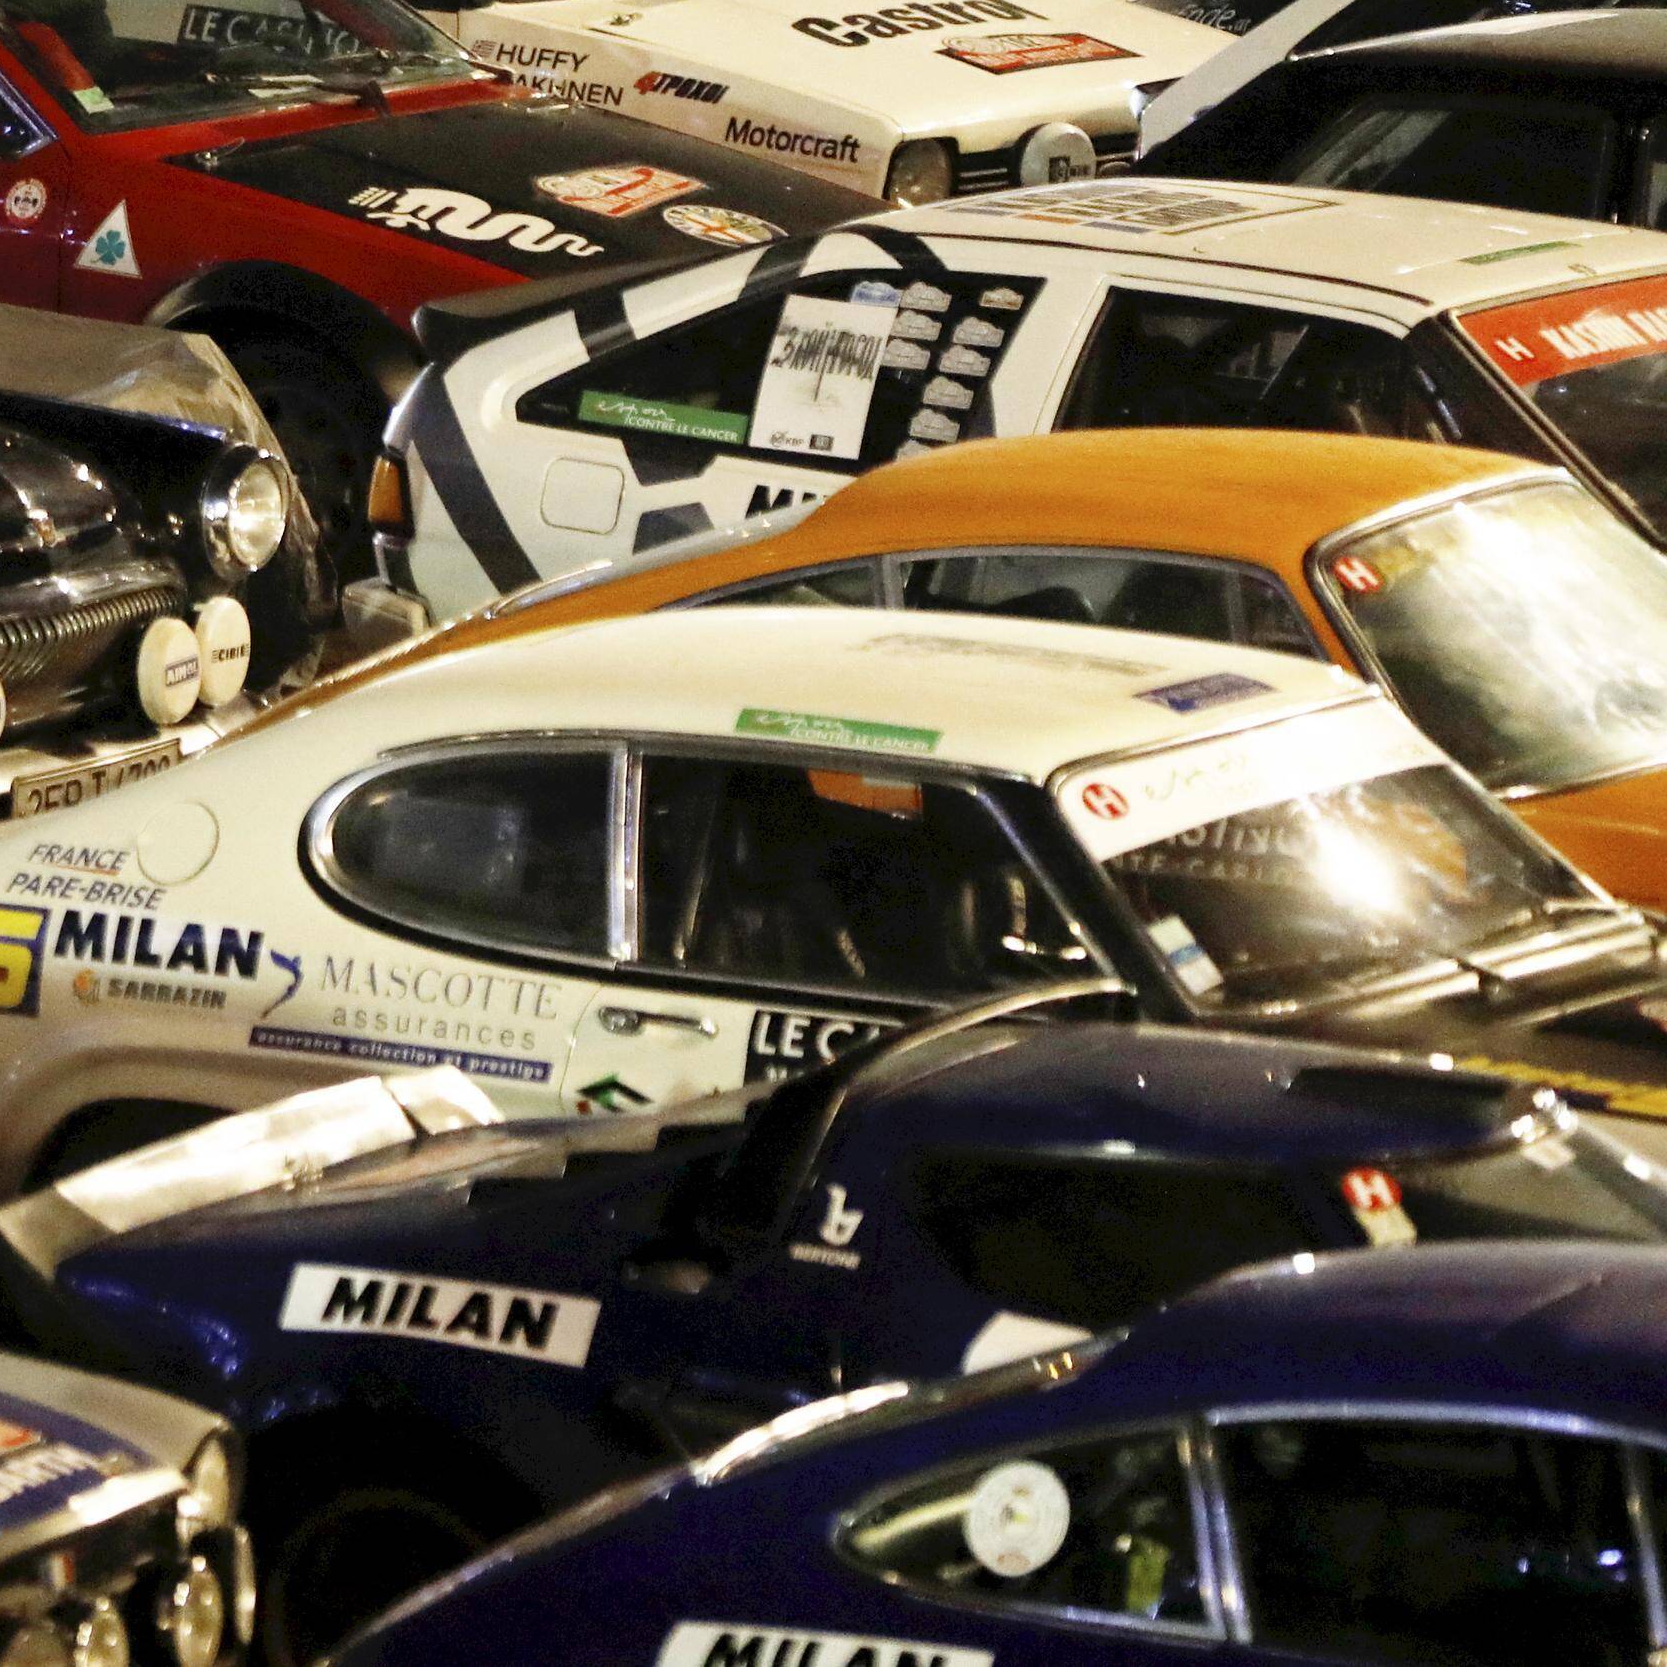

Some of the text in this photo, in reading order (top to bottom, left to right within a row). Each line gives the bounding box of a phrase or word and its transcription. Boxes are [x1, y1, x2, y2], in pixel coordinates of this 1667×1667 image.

[495, 42, 589, 72] HUFFY
[723, 115, 861, 164] Motorcraft
[1496, 336, 1535, 362] H
[631, 413, 678, 435] CONTRE
[695, 424, 739, 446] CANCER
[1338, 557, 1379, 590] H
[1083, 783, 1128, 820] H
[29, 842, 131, 875] FRANCE
[6, 872, 167, 912] PARE-BRISE
[53, 909, 264, 982] MILAN
[106, 979, 228, 1010] SARRAZIN
[319, 954, 560, 1023] MASCOTTE
[331, 1005, 538, 1051] assurances
[756, 1012, 807, 1056] LE
[349, 1037, 437, 1065] collection
[470, 1054, 550, 1083] prestige
[1349, 1170, 1399, 1211] H
[321, 1279, 560, 1352] MILAN
